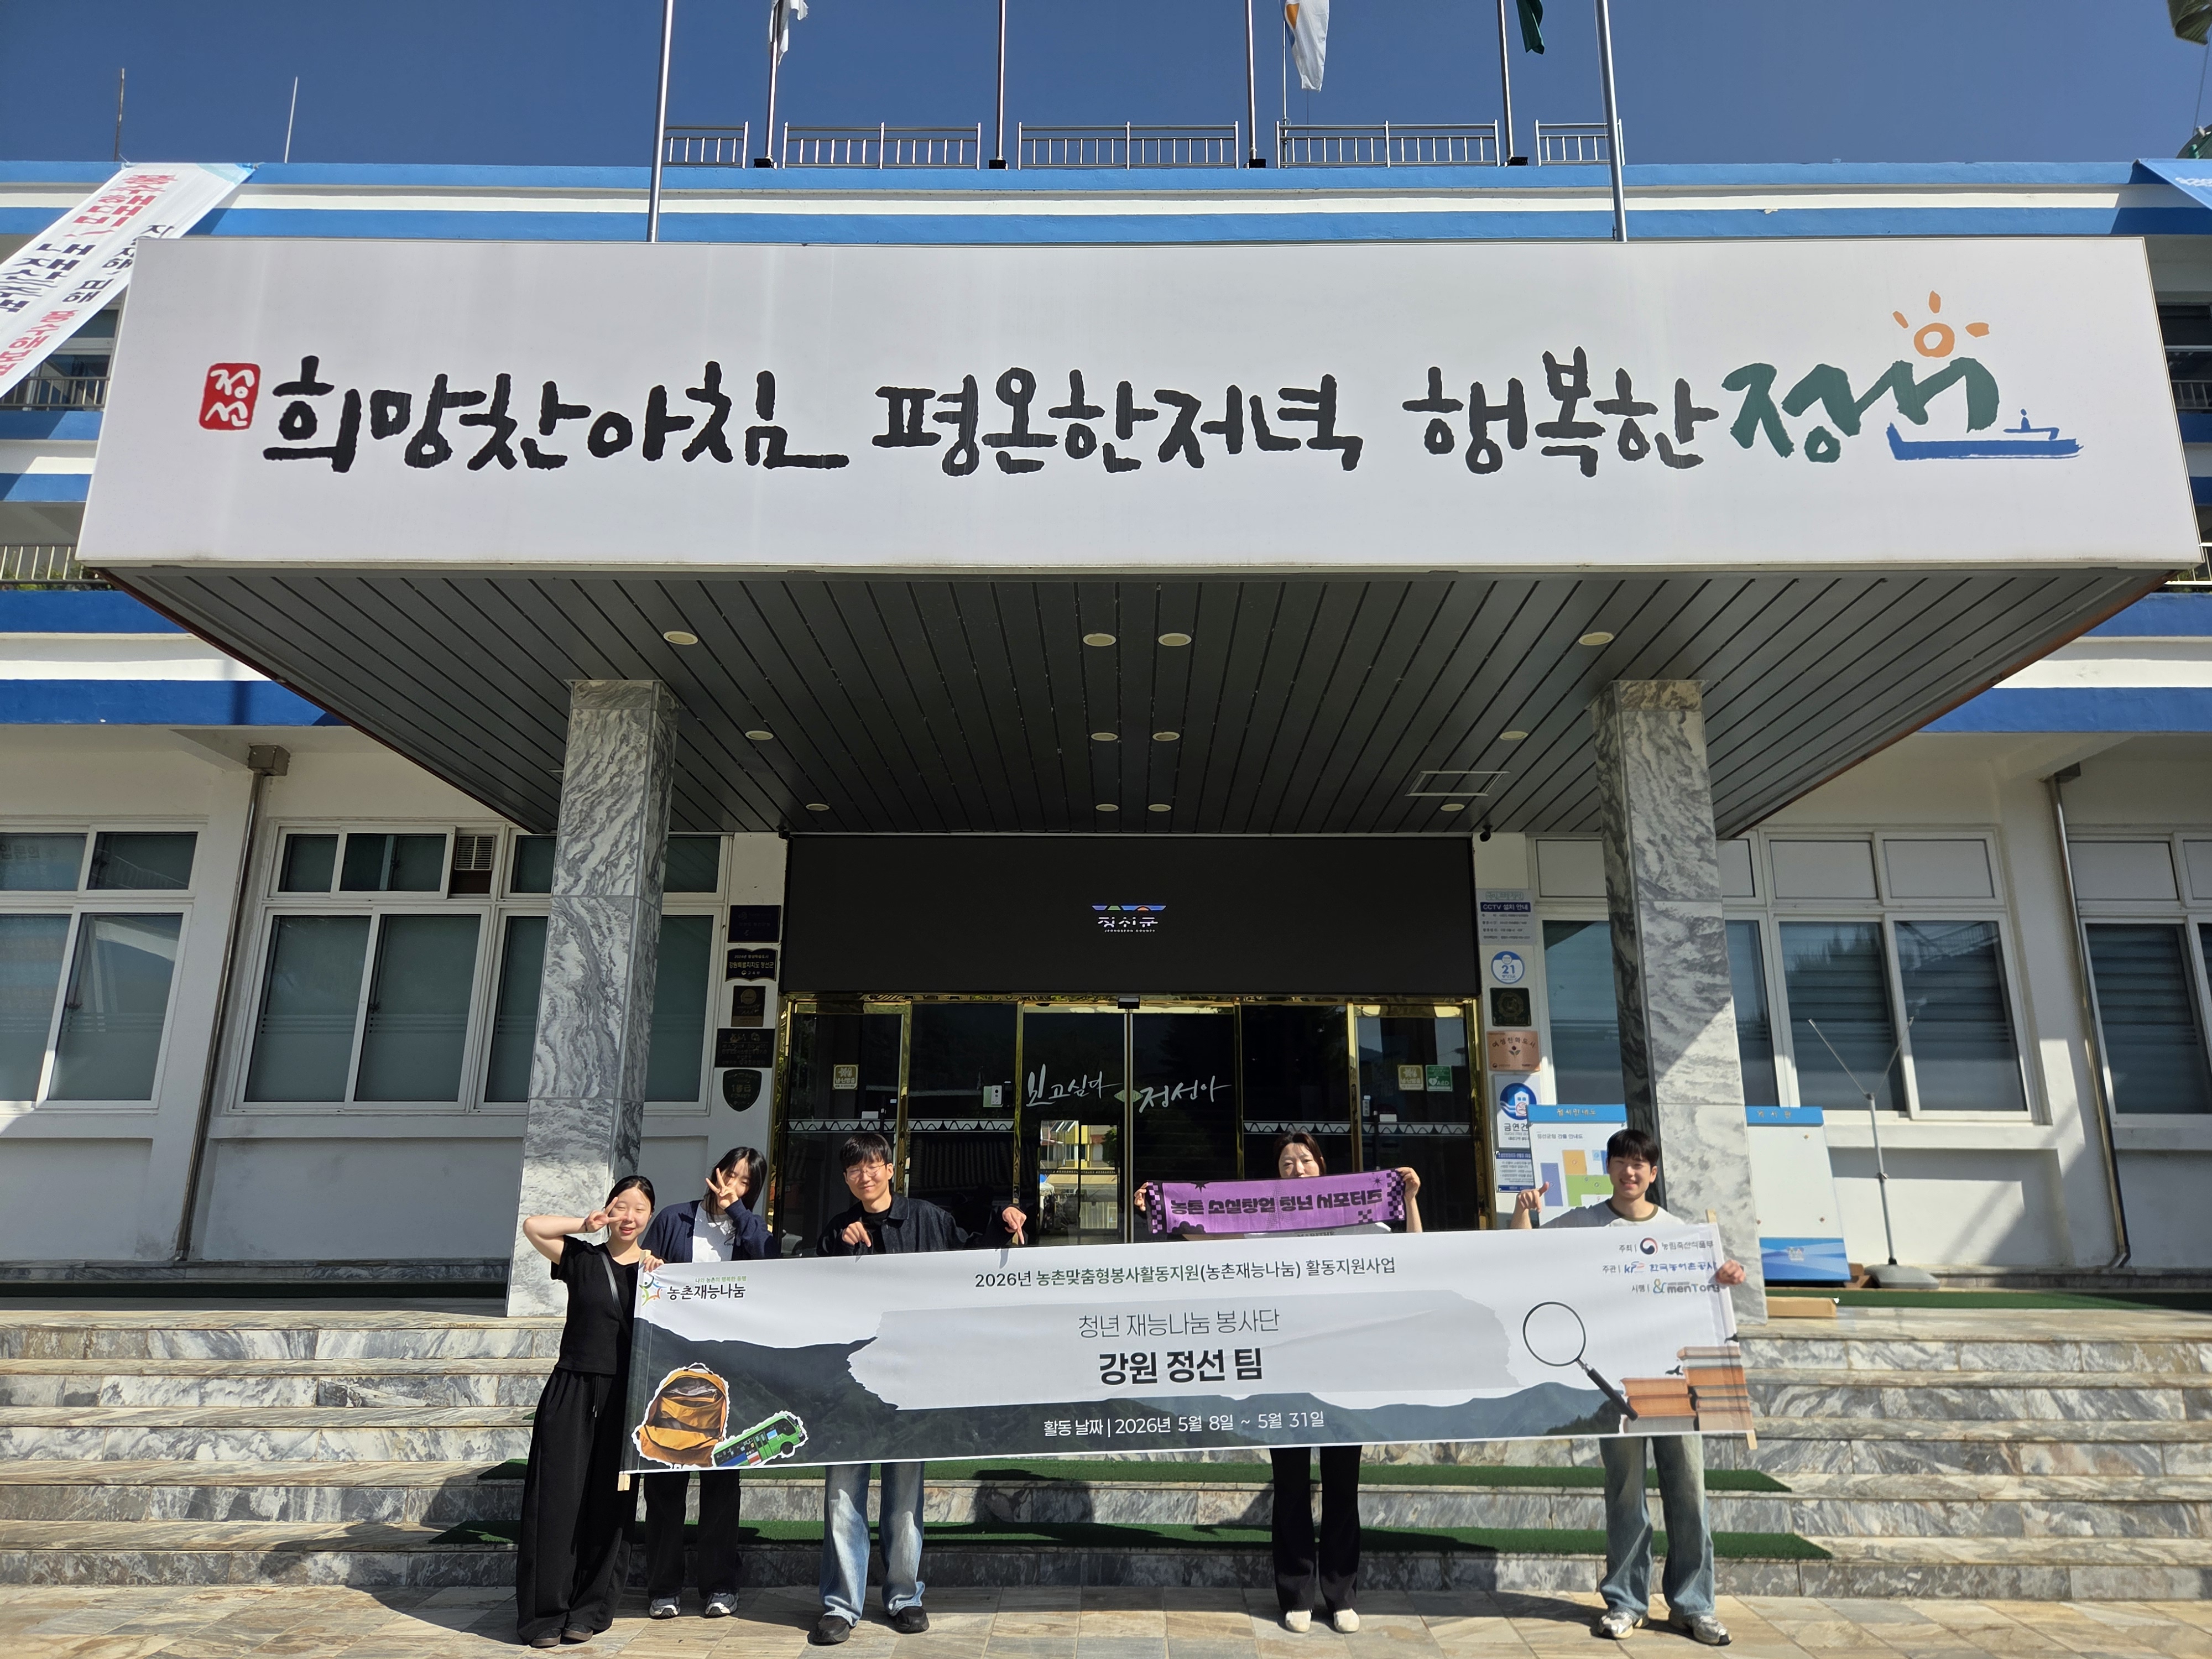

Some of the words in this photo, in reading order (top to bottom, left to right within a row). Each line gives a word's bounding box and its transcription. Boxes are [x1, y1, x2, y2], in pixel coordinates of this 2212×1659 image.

[210, 369, 255, 427] 정선
[1501, 964, 1515, 974] 21
[1492, 1037, 1536, 1048] 여성친화도시
[1171, 1199, 1204, 1215] 농촌
[1280, 1194, 1313, 1211] 청년
[1317, 1188, 1383, 1209] 서포터즈
[975, 1270, 1031, 1287] 2026년
[1036, 1260, 1302, 1286] 농촌맞춤형봉사활동지원(농촌재능나눔)
[1305, 1256, 1395, 1276] 활동지원사업
[667, 1284, 746, 1300] 농촌재능나눔
[1079, 1314, 1120, 1338] 청년
[1126, 1311, 1210, 1337] 재능나눔
[1217, 1308, 1280, 1334] 봉사단
[1099, 1352, 1157, 1386] 강원
[1167, 1349, 1225, 1383] 정선
[1234, 1348, 1262, 1380] 팀
[1044, 1420, 1072, 1437] 활동
[1075, 1419, 1103, 1436] 날짜
[1115, 1416, 1171, 1434] 2026년
[1177, 1415, 1203, 1432] 5월
[1209, 1415, 1234, 1431] 8일
[1258, 1412, 1283, 1429] 5월
[1289, 1411, 1324, 1428] 31일
